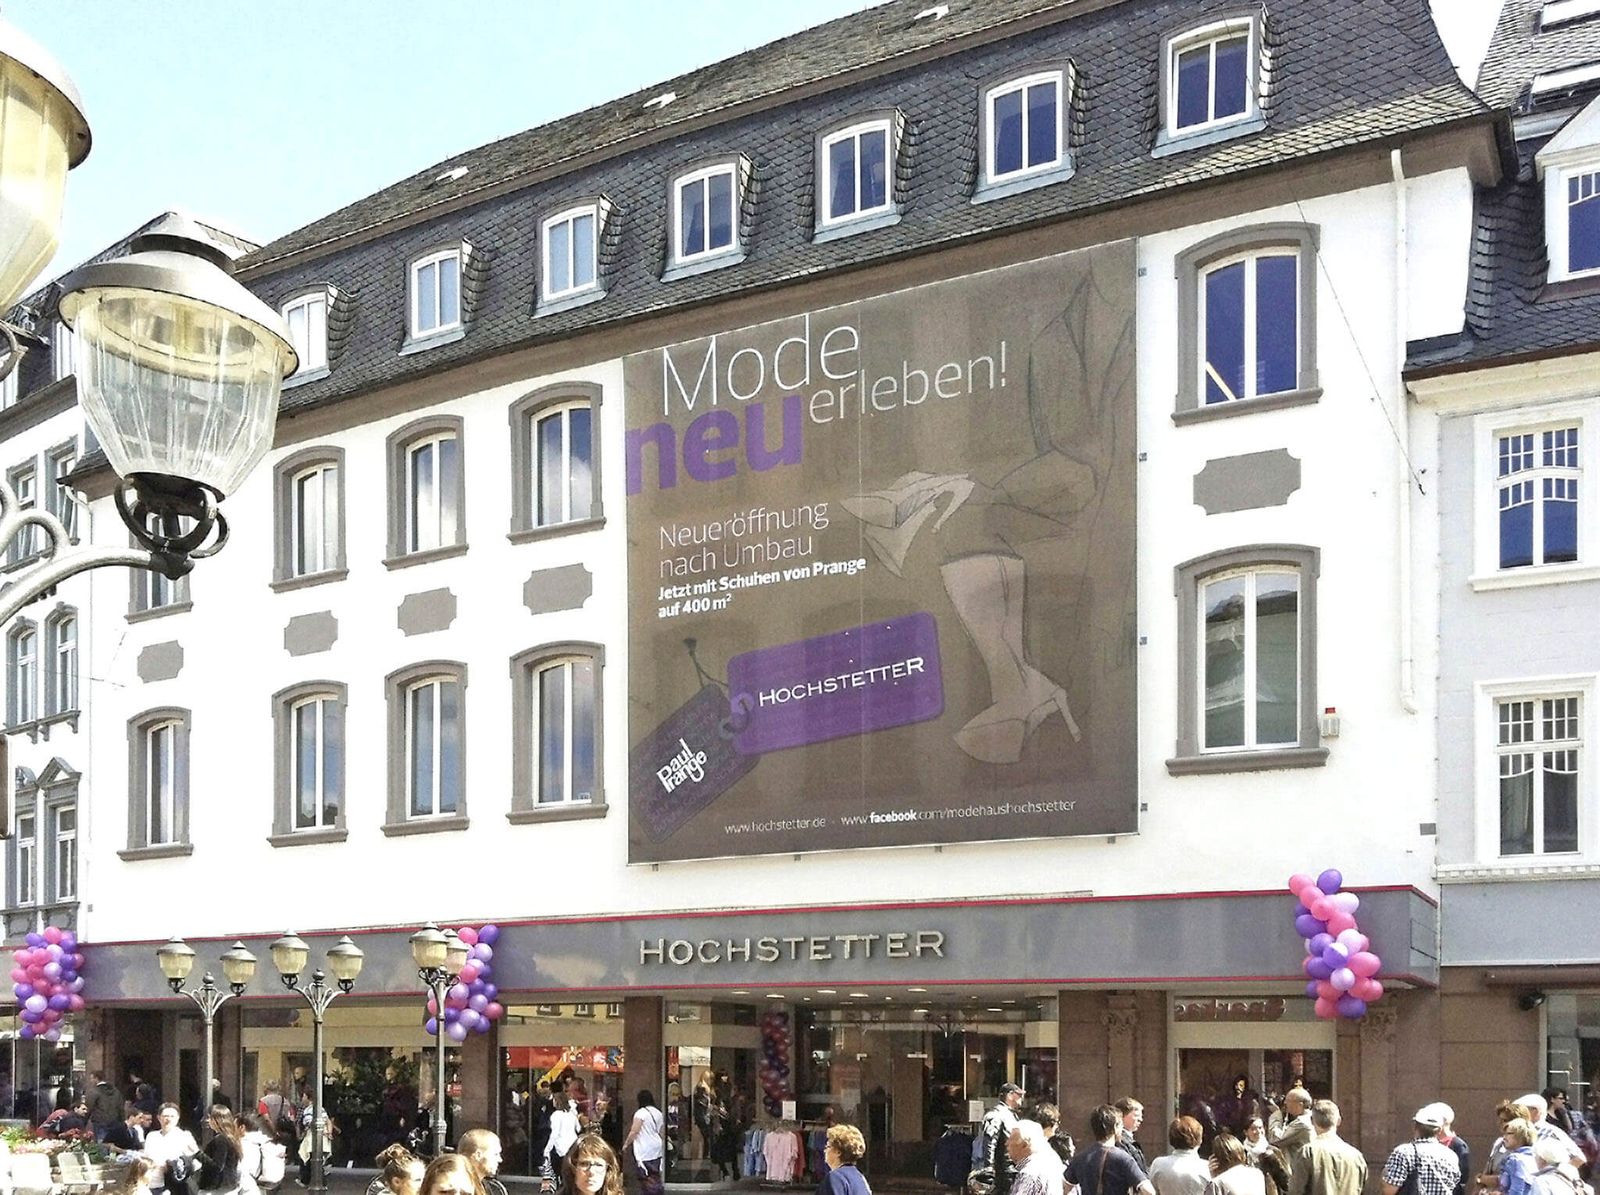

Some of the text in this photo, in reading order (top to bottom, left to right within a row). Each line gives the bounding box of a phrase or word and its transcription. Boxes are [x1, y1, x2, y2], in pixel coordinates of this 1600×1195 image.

[663, 313, 859, 415] Mode
[809, 341, 1007, 424] erleben!
[625, 395, 802, 495] neu
[659, 502, 830, 550] Neueröffnung
[658, 557, 866, 600] Jetzt mit Schuhen von Prange
[660, 536, 812, 578] nach Umbau
[658, 601, 681, 618] auf
[682, 597, 711, 614] 400
[758, 657, 925, 707] HOCHSTETTER
[656, 737, 694, 781] Paul
[724, 816, 826, 835] www.hochstetter.de
[639, 930, 945, 965] HOCHSTETTER
